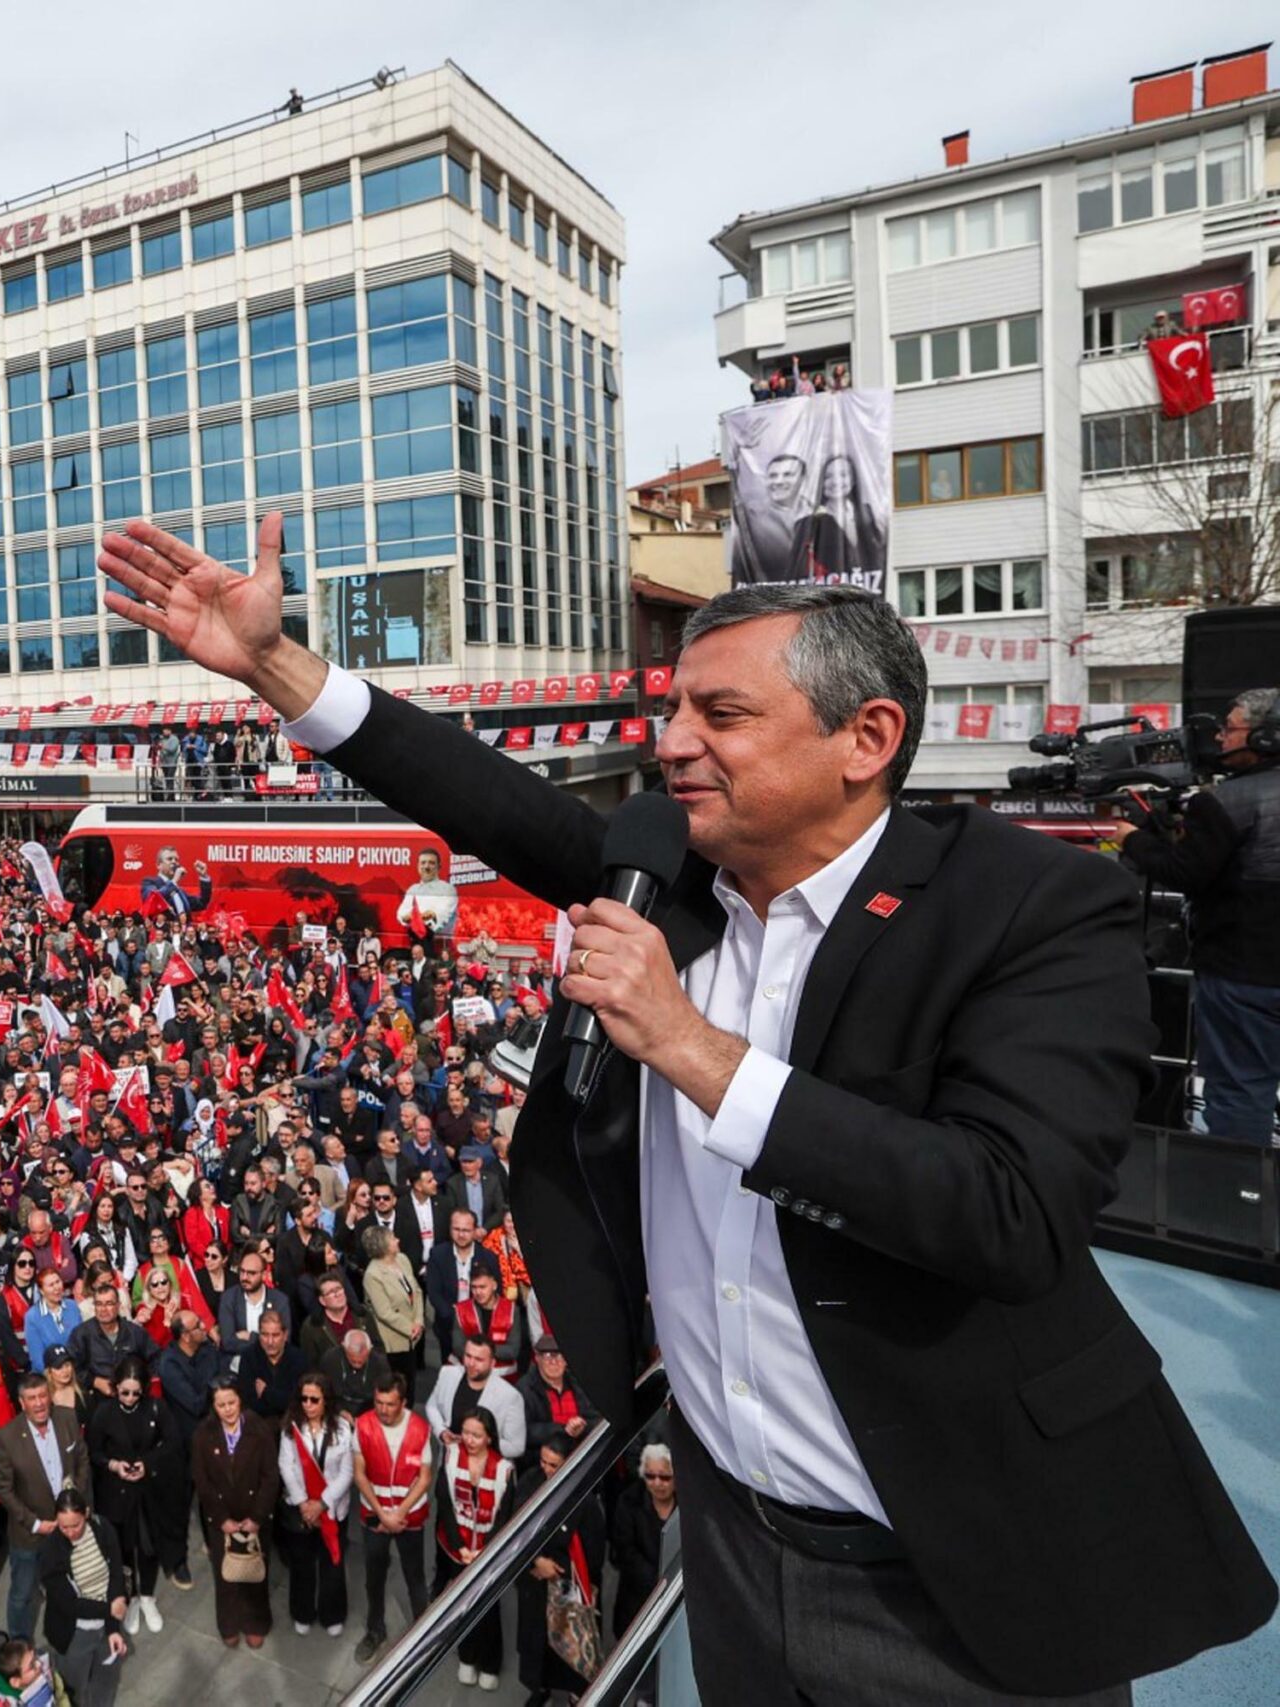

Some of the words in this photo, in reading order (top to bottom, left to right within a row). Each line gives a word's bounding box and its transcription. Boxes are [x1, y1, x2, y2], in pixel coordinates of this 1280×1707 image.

[80, 206, 119, 229] ÖZEL
[990, 801, 1036, 814] CEBECİ
[358, 847, 411, 867] ÇIKIYOR
